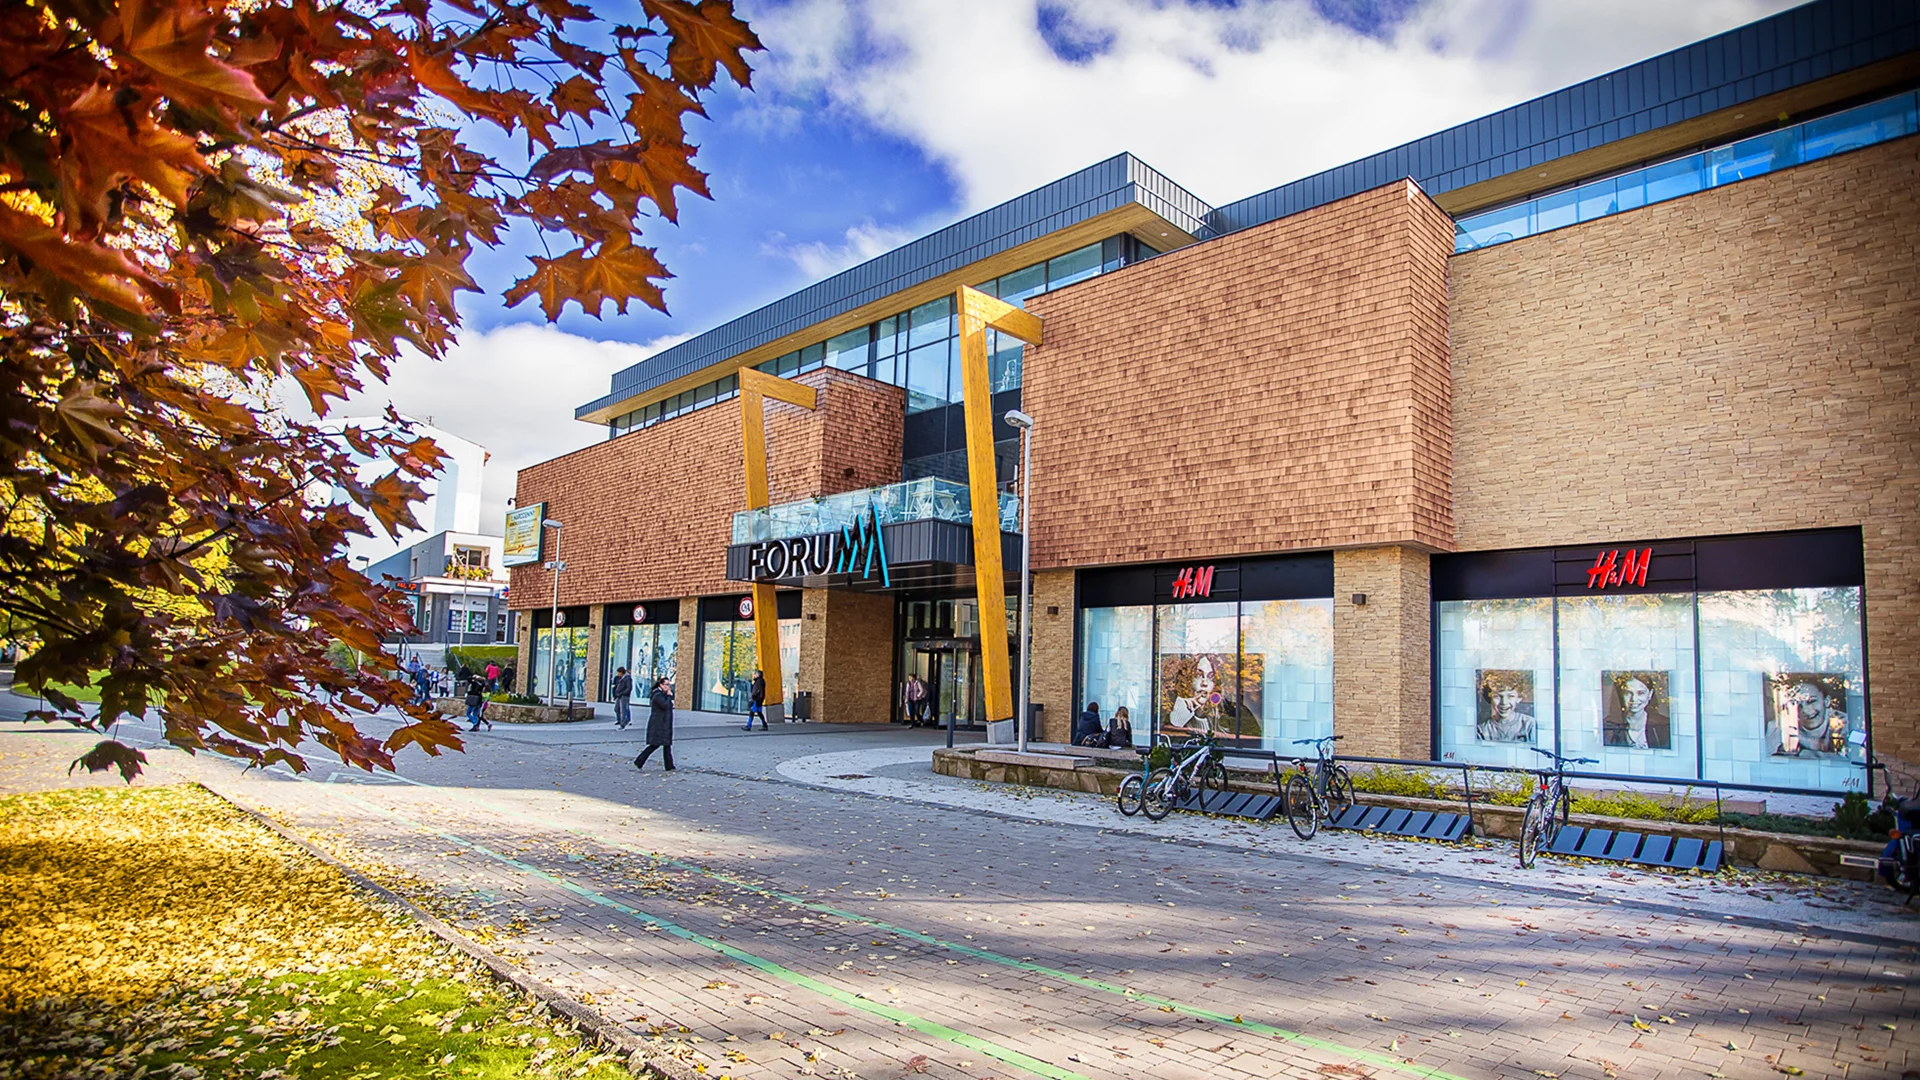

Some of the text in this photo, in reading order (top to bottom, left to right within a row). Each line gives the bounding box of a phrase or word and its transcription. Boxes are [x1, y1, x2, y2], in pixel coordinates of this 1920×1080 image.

[750, 500, 890, 588] FORUM
[1172, 565, 1215, 599] H&M
[1586, 547, 1653, 590] H&M
